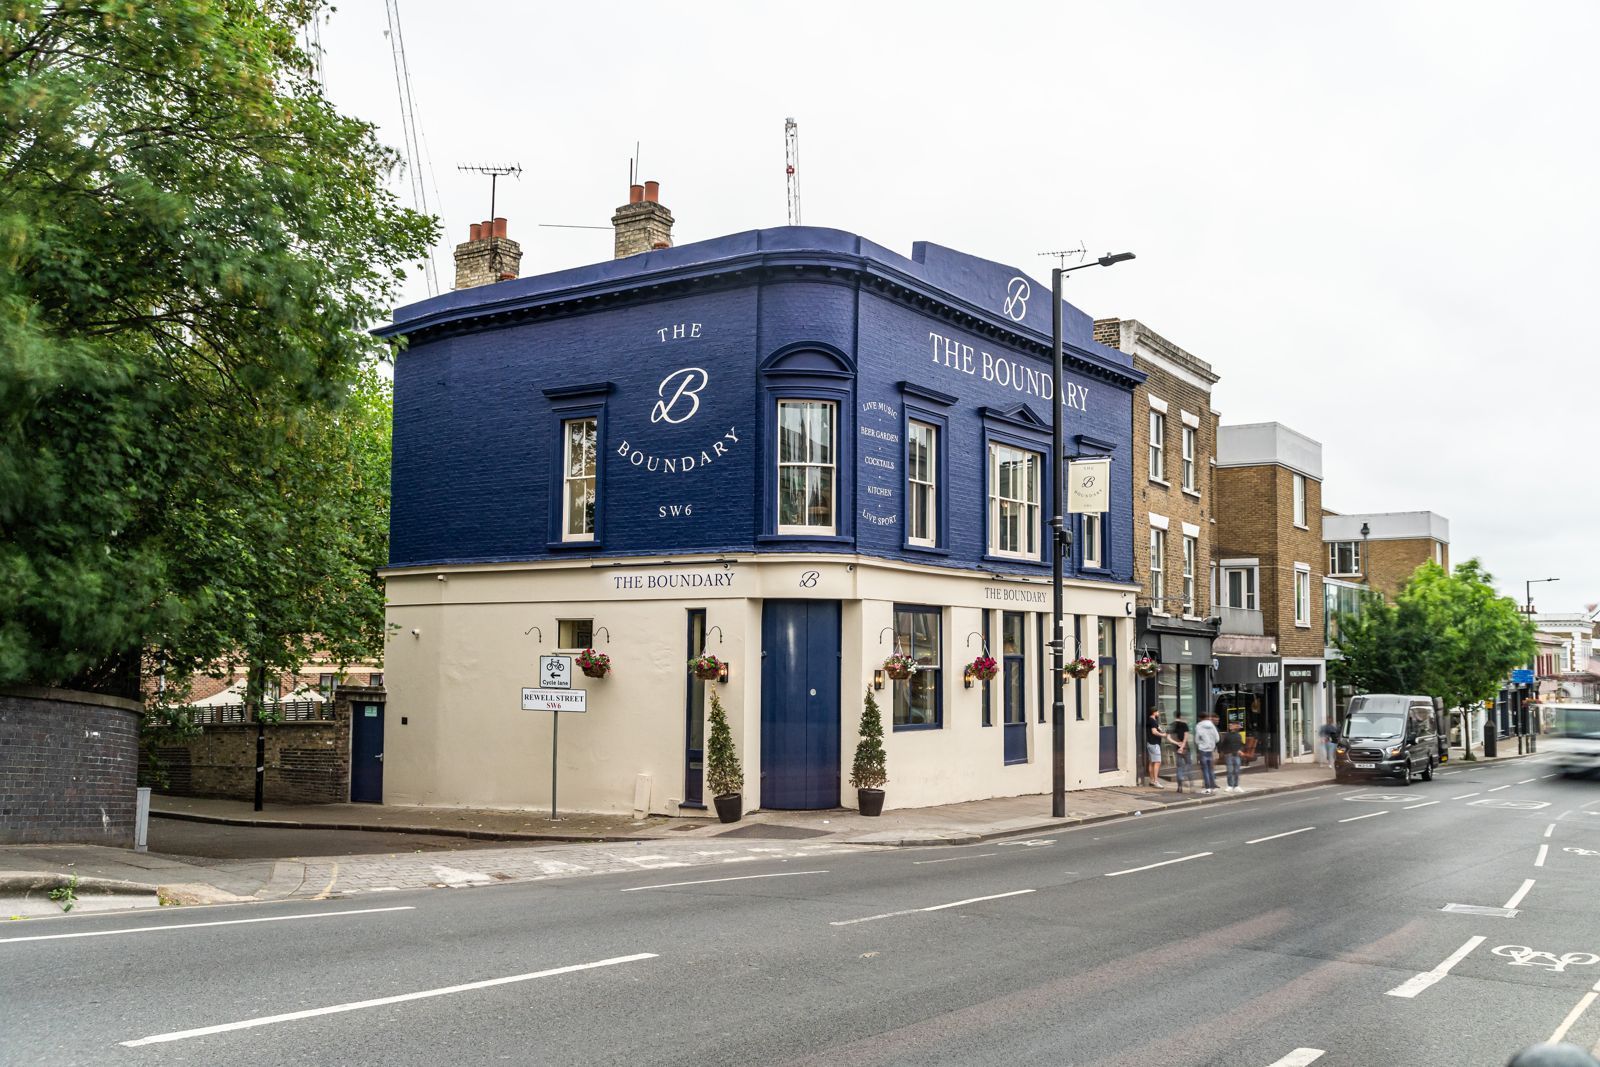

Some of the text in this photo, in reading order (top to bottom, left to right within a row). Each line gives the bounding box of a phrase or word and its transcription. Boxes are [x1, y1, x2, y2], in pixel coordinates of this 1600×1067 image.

[657, 323, 702, 342] THE
[929, 332, 1089, 412] THE BOUNDRY
[651, 367, 708, 424] B
[863, 401, 898, 419] LIVE MUSIC
[861, 426, 899, 443] BEER GARDEN
[617, 426, 739, 473] BOUNDARY
[864, 456, 895, 470] COCKTAILS
[867, 485, 892, 497] KITCHEN
[659, 504, 692, 518] SW6
[862, 509, 897, 526] LIVE SPORT
[614, 572, 735, 589] THE BOUNDARY
[985, 587, 1046, 602] THE BOUNDARY
[555, 694, 584, 702] STREET
